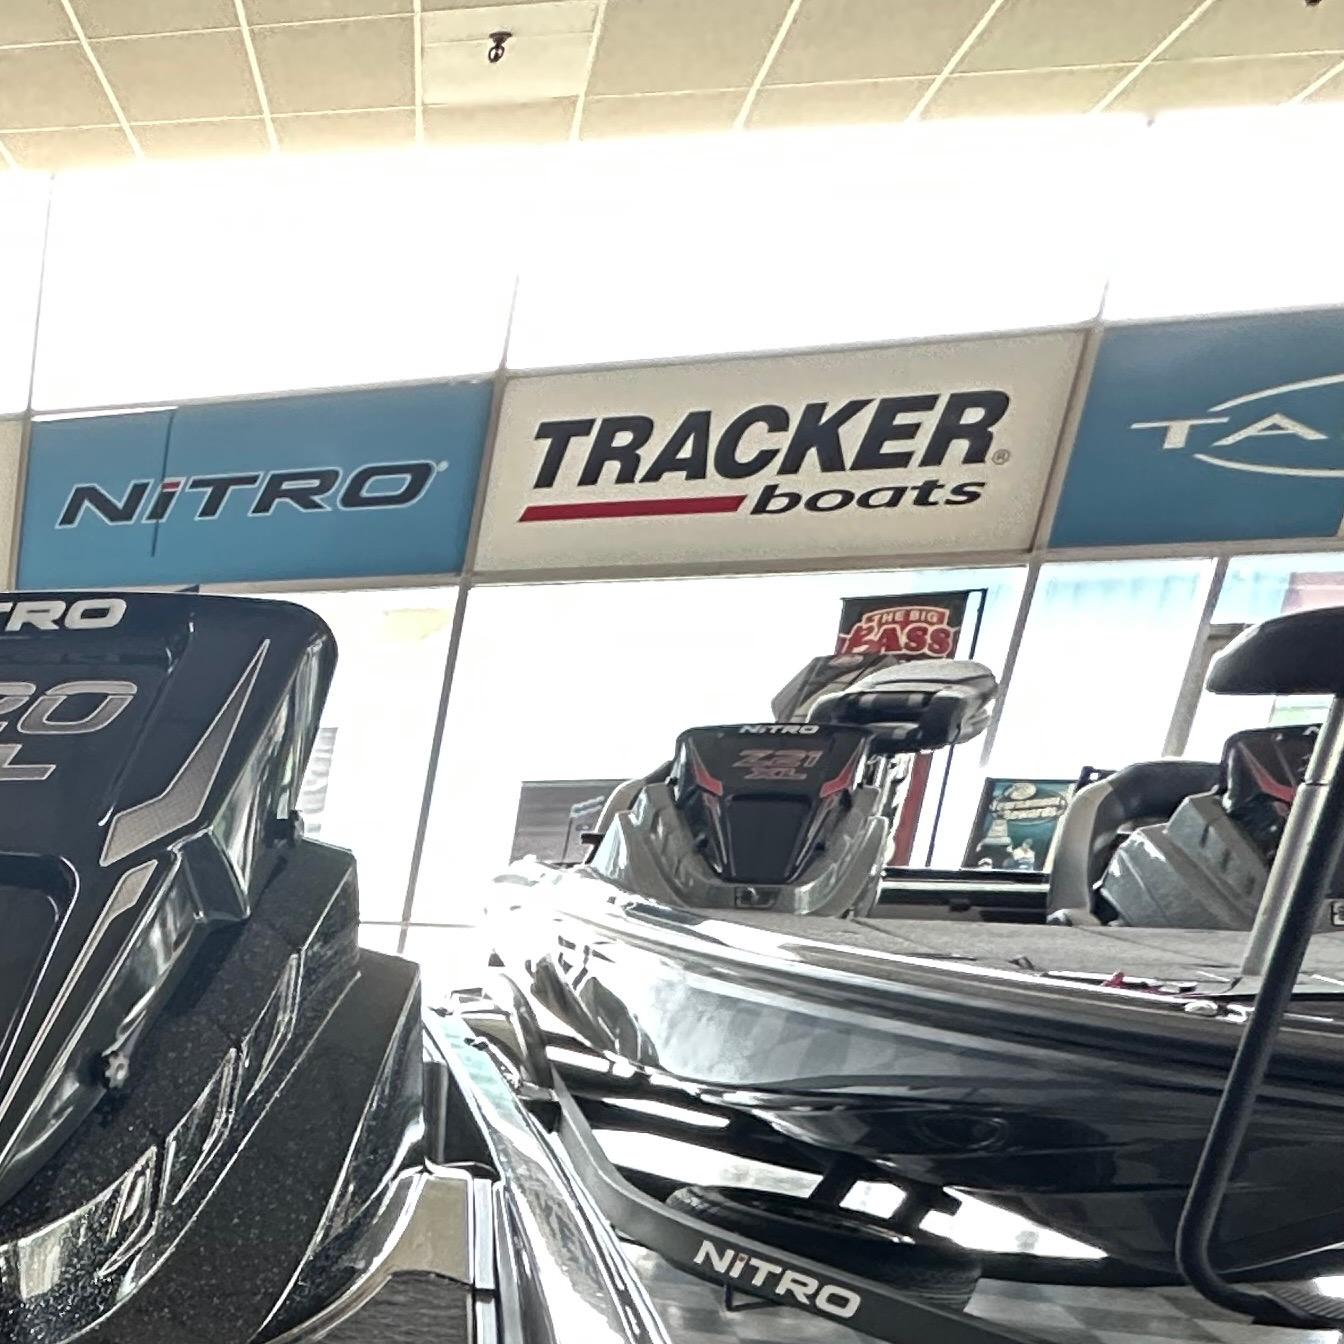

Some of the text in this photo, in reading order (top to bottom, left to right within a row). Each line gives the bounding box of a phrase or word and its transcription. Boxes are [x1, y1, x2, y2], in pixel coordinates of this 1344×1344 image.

[533, 389, 1011, 489] TRACKER
[1130, 412, 1344, 450] TA
[749, 478, 987, 515] boats
[874, 610, 938, 625] THE BIG
[843, 622, 953, 657] BASS
